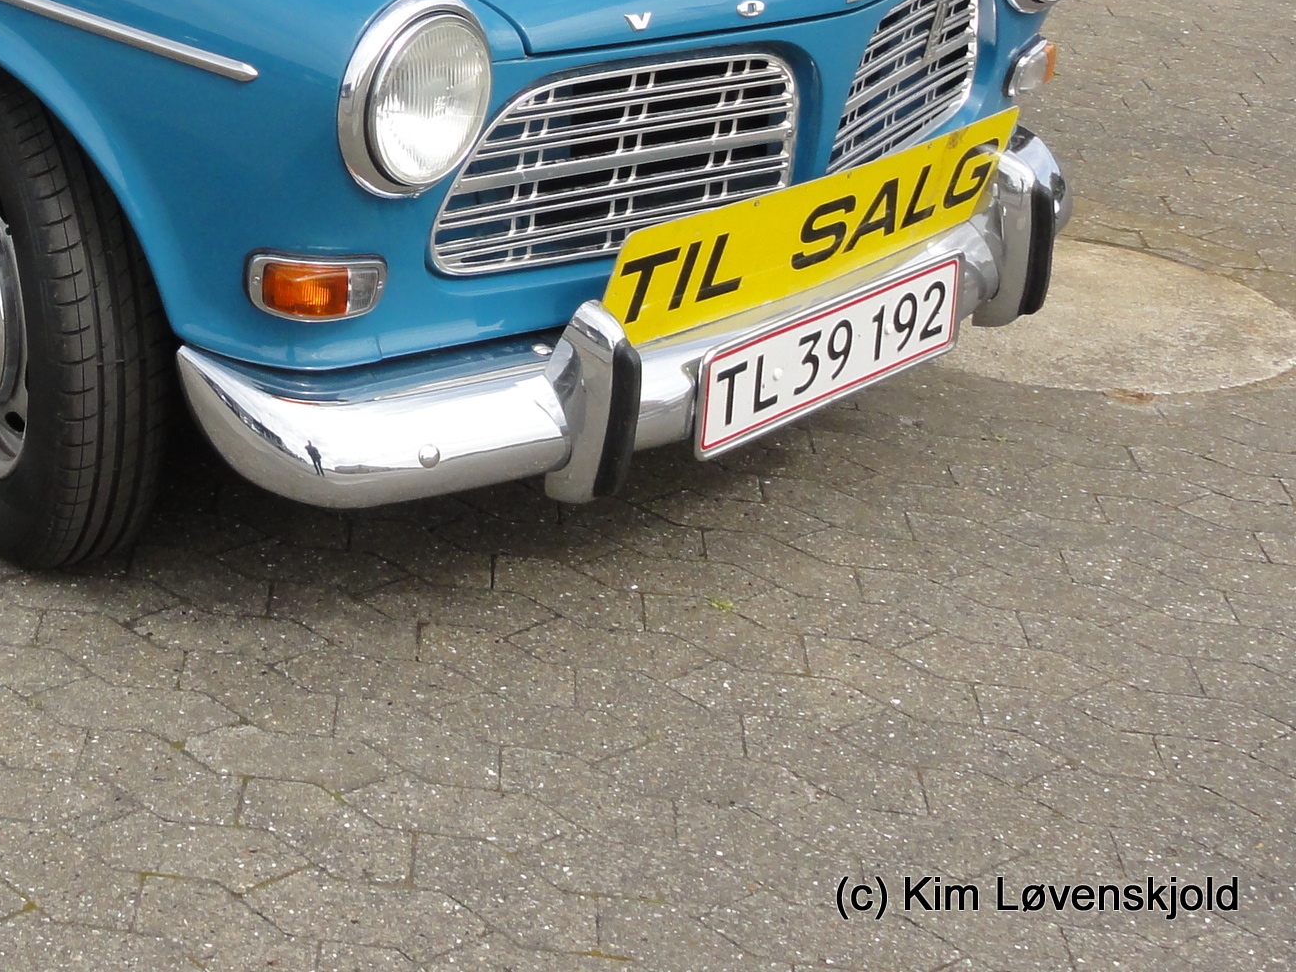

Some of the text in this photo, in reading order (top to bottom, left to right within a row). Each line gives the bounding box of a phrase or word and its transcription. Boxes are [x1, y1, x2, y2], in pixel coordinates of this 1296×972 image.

[619, 138, 999, 325] TIL SALG
[716, 280, 946, 426] TL 39 192
